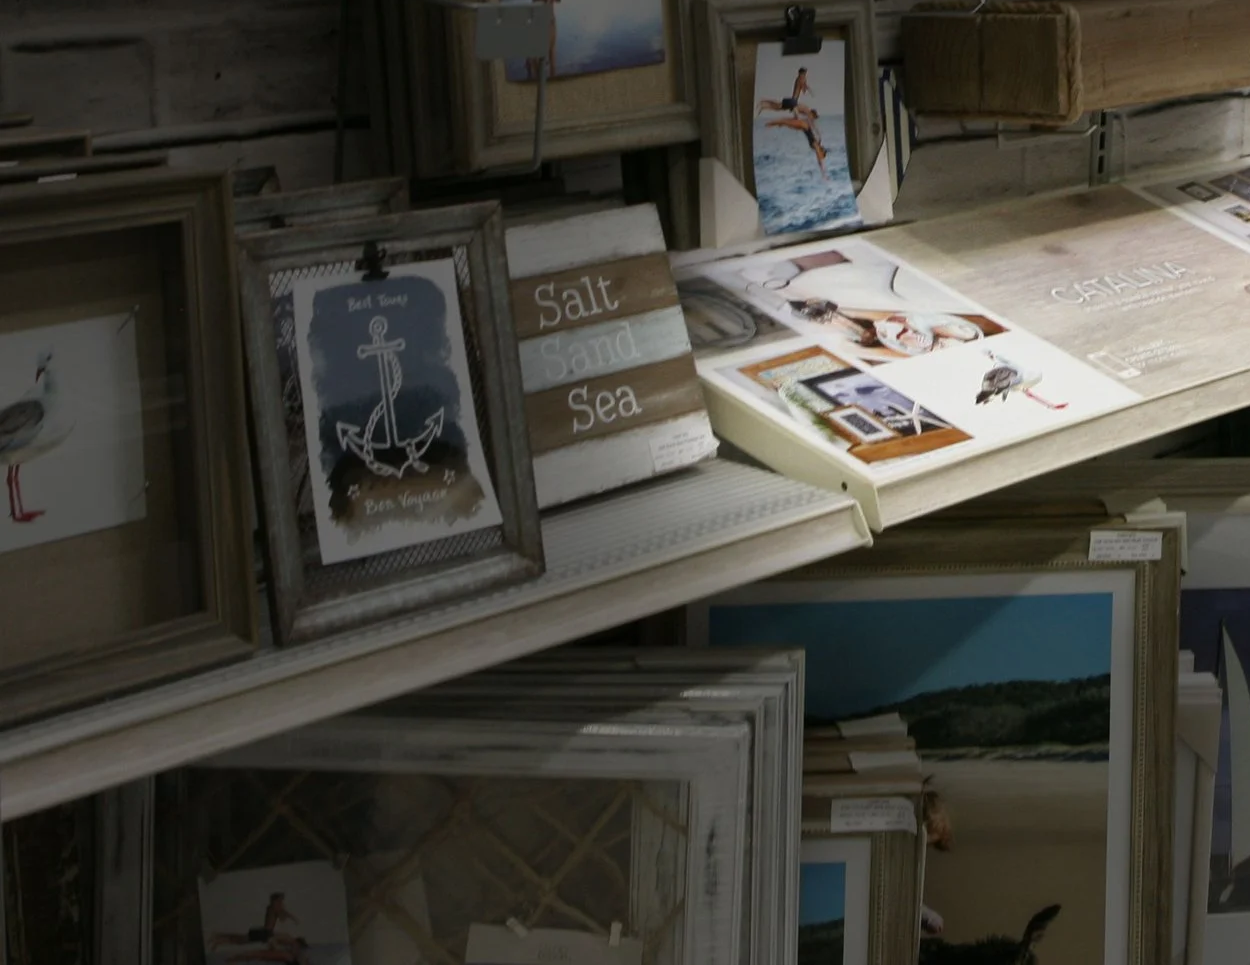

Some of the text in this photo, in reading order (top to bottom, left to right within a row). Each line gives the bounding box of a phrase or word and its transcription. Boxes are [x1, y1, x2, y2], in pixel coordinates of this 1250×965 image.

[534, 275, 620, 330] Salt
[1051, 260, 1188, 305] CATALINA
[540, 321, 642, 381] Sand
[567, 385, 643, 435] Sea
